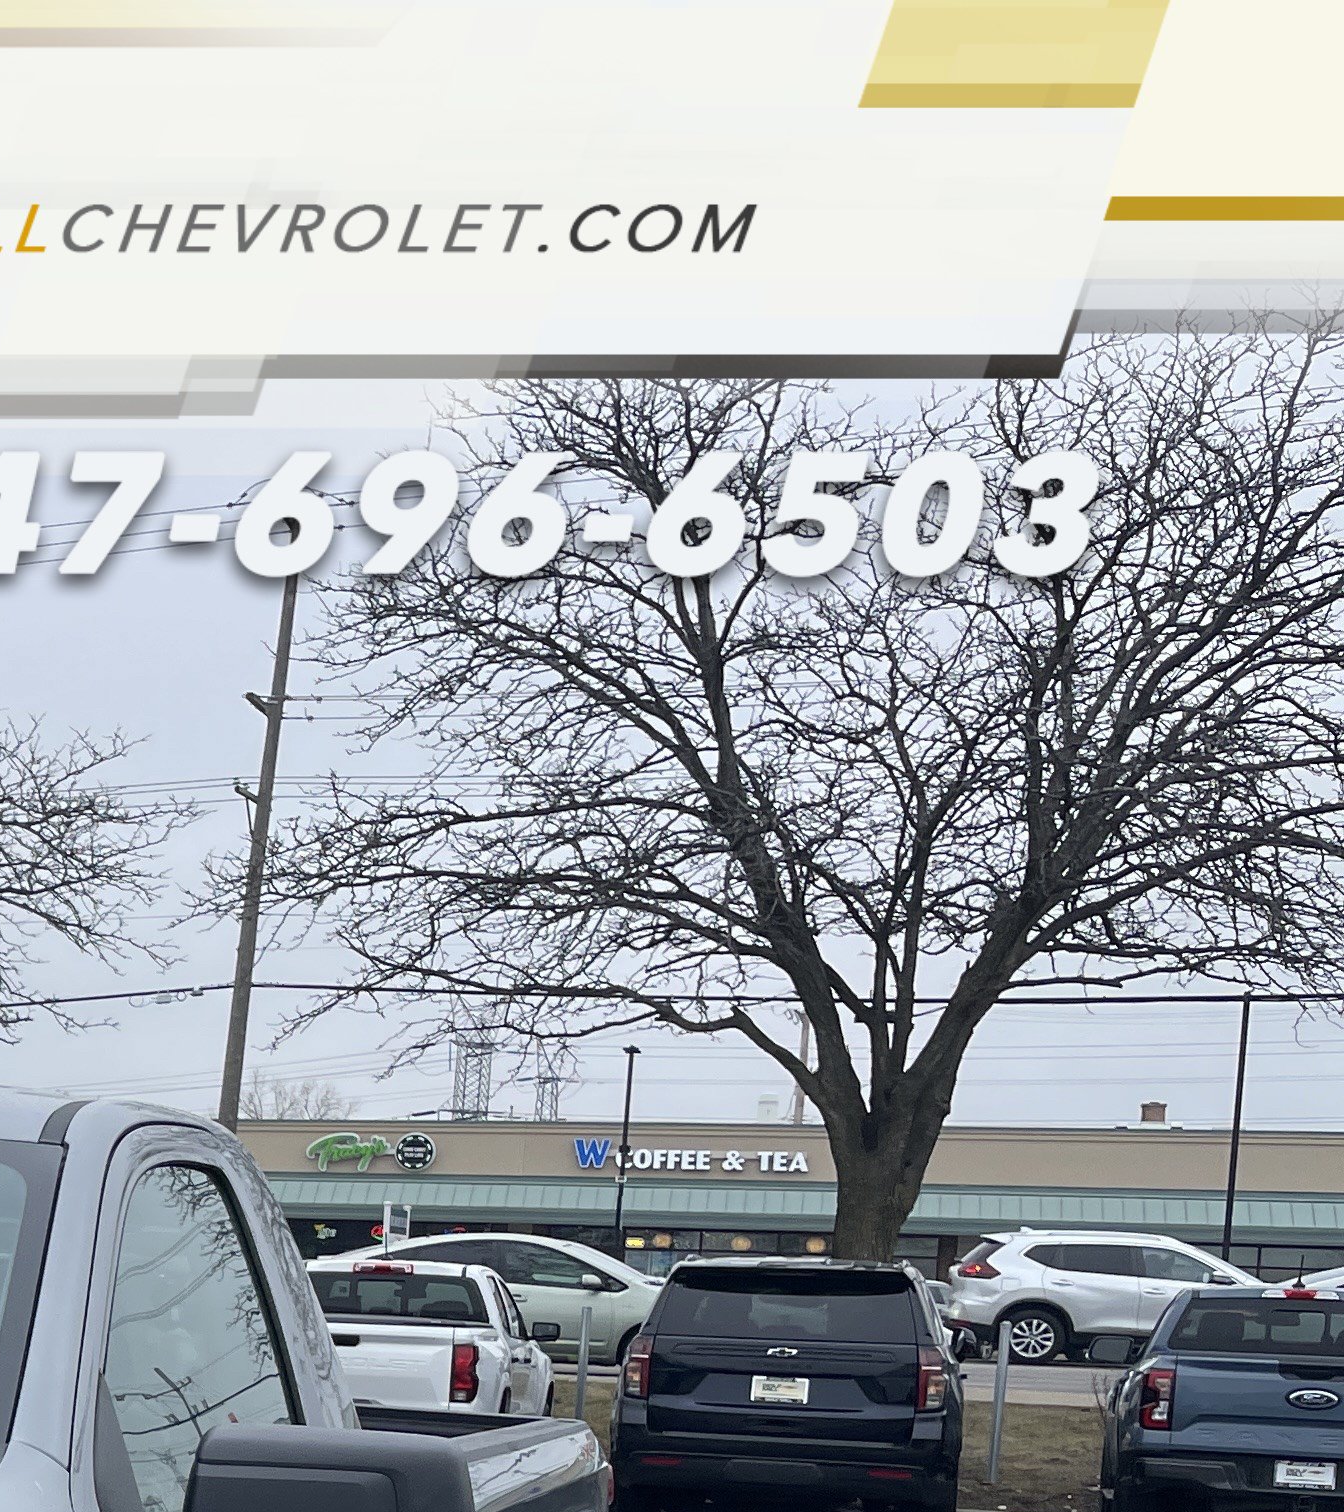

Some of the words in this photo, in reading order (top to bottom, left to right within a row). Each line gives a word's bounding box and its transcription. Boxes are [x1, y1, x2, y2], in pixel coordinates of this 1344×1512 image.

[574, 1138, 611, 1168] W
[615, 1148, 711, 1171] COFFEE
[721, 1150, 745, 1171] &
[758, 1151, 809, 1173] TEA
